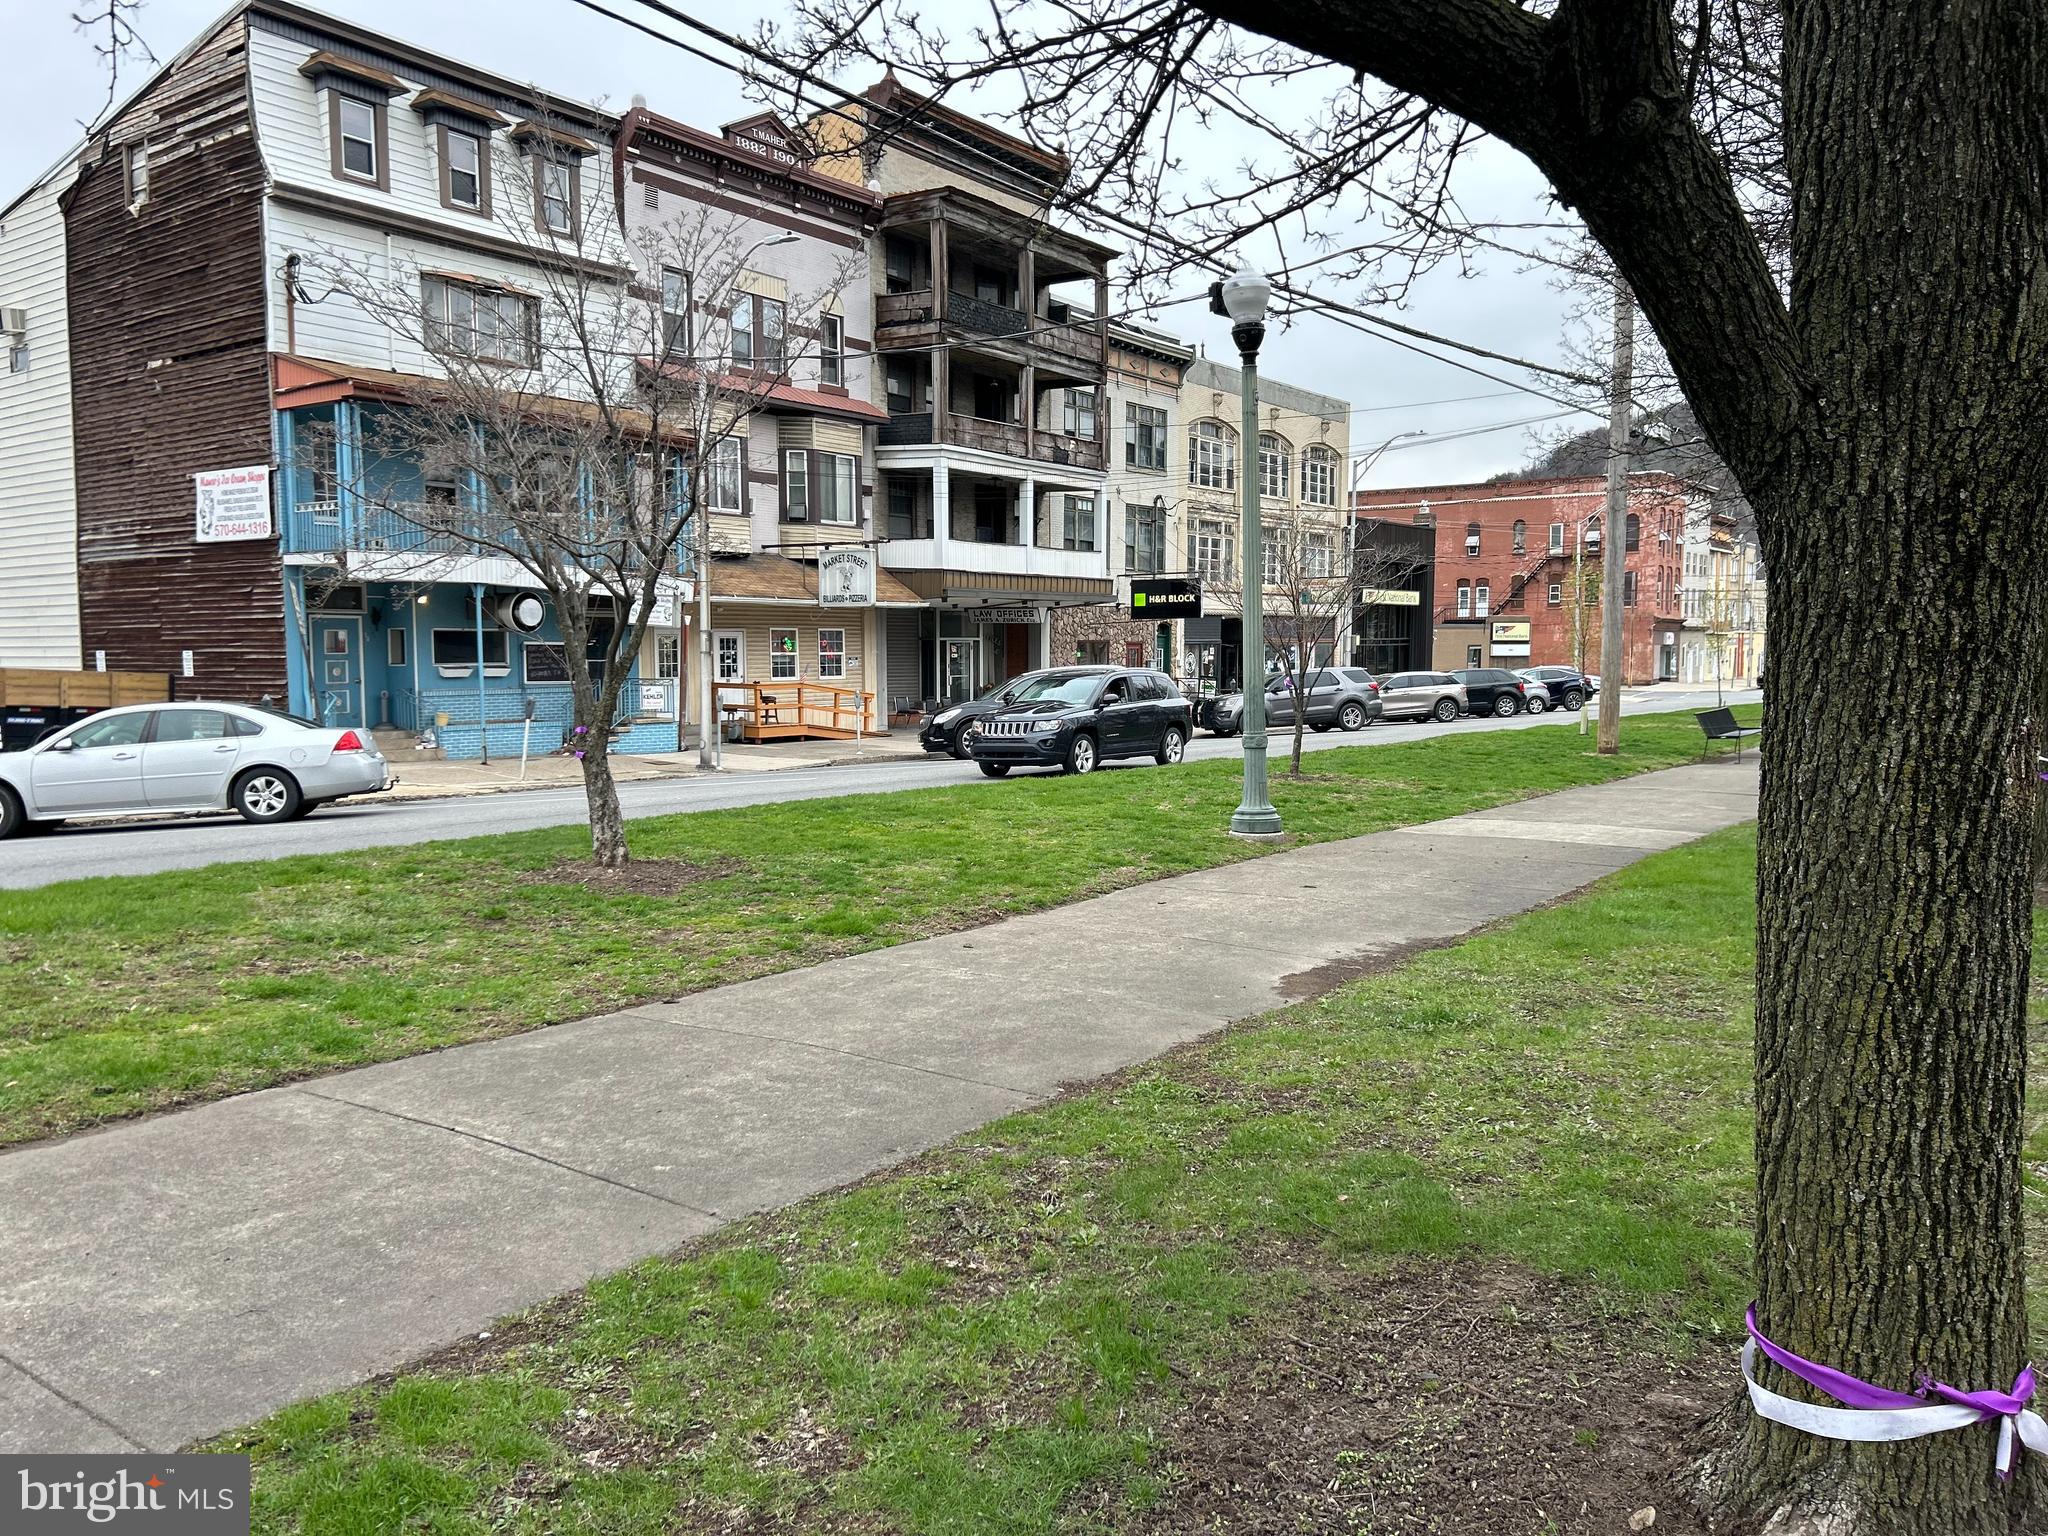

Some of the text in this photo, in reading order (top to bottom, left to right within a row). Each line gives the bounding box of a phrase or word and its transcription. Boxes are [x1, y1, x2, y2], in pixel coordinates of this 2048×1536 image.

[736, 136, 766, 156] 1882
[215, 521, 268, 536] 570-644-1316
[822, 554, 868, 570] MARKET STREET
[848, 594, 868, 603] PIZZERIA
[1148, 594, 1196, 604] H&R BLOCK
[973, 610, 1035, 618] LAW OFFICES
